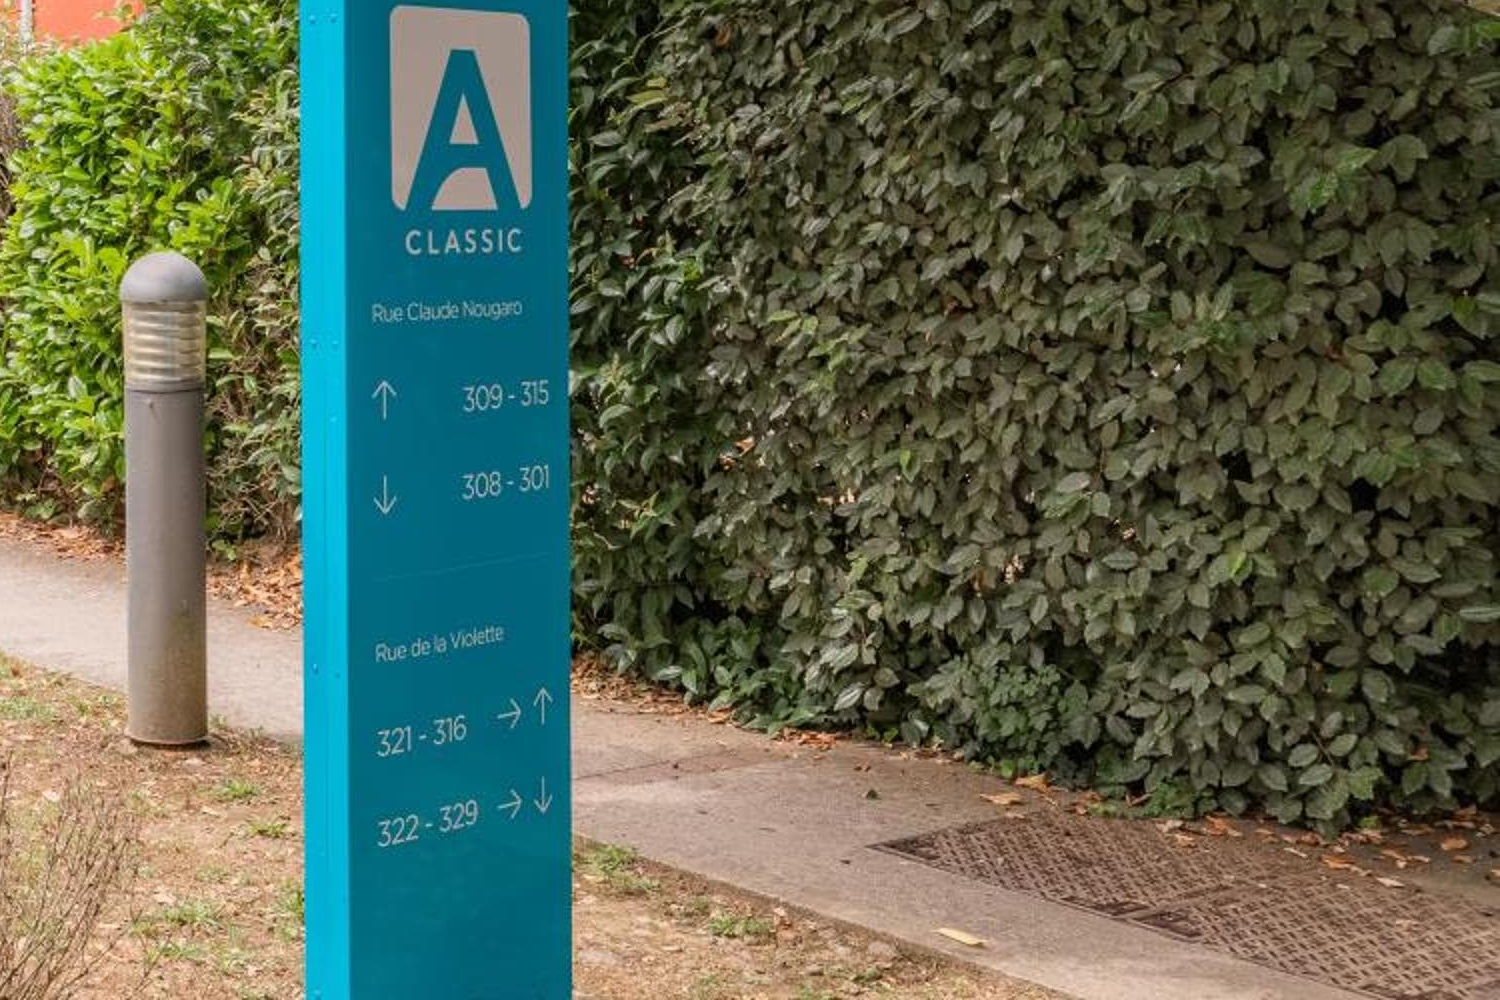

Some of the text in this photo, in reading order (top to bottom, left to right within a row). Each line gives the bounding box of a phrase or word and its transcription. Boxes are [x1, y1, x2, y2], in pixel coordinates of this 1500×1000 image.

[405, 48, 522, 211] A
[405, 228, 524, 255] CLASSIC
[372, 300, 522, 323] Rue Claude Nougaro
[463, 384, 502, 412] 309
[520, 380, 549, 407] 315
[462, 471, 502, 500] 308
[519, 464, 550, 492] 301
[375, 624, 504, 663] Rue de la Violette
[376, 726, 412, 757] 321
[433, 715, 467, 745] 316
[376, 815, 419, 848] 322
[439, 800, 479, 834] 329
